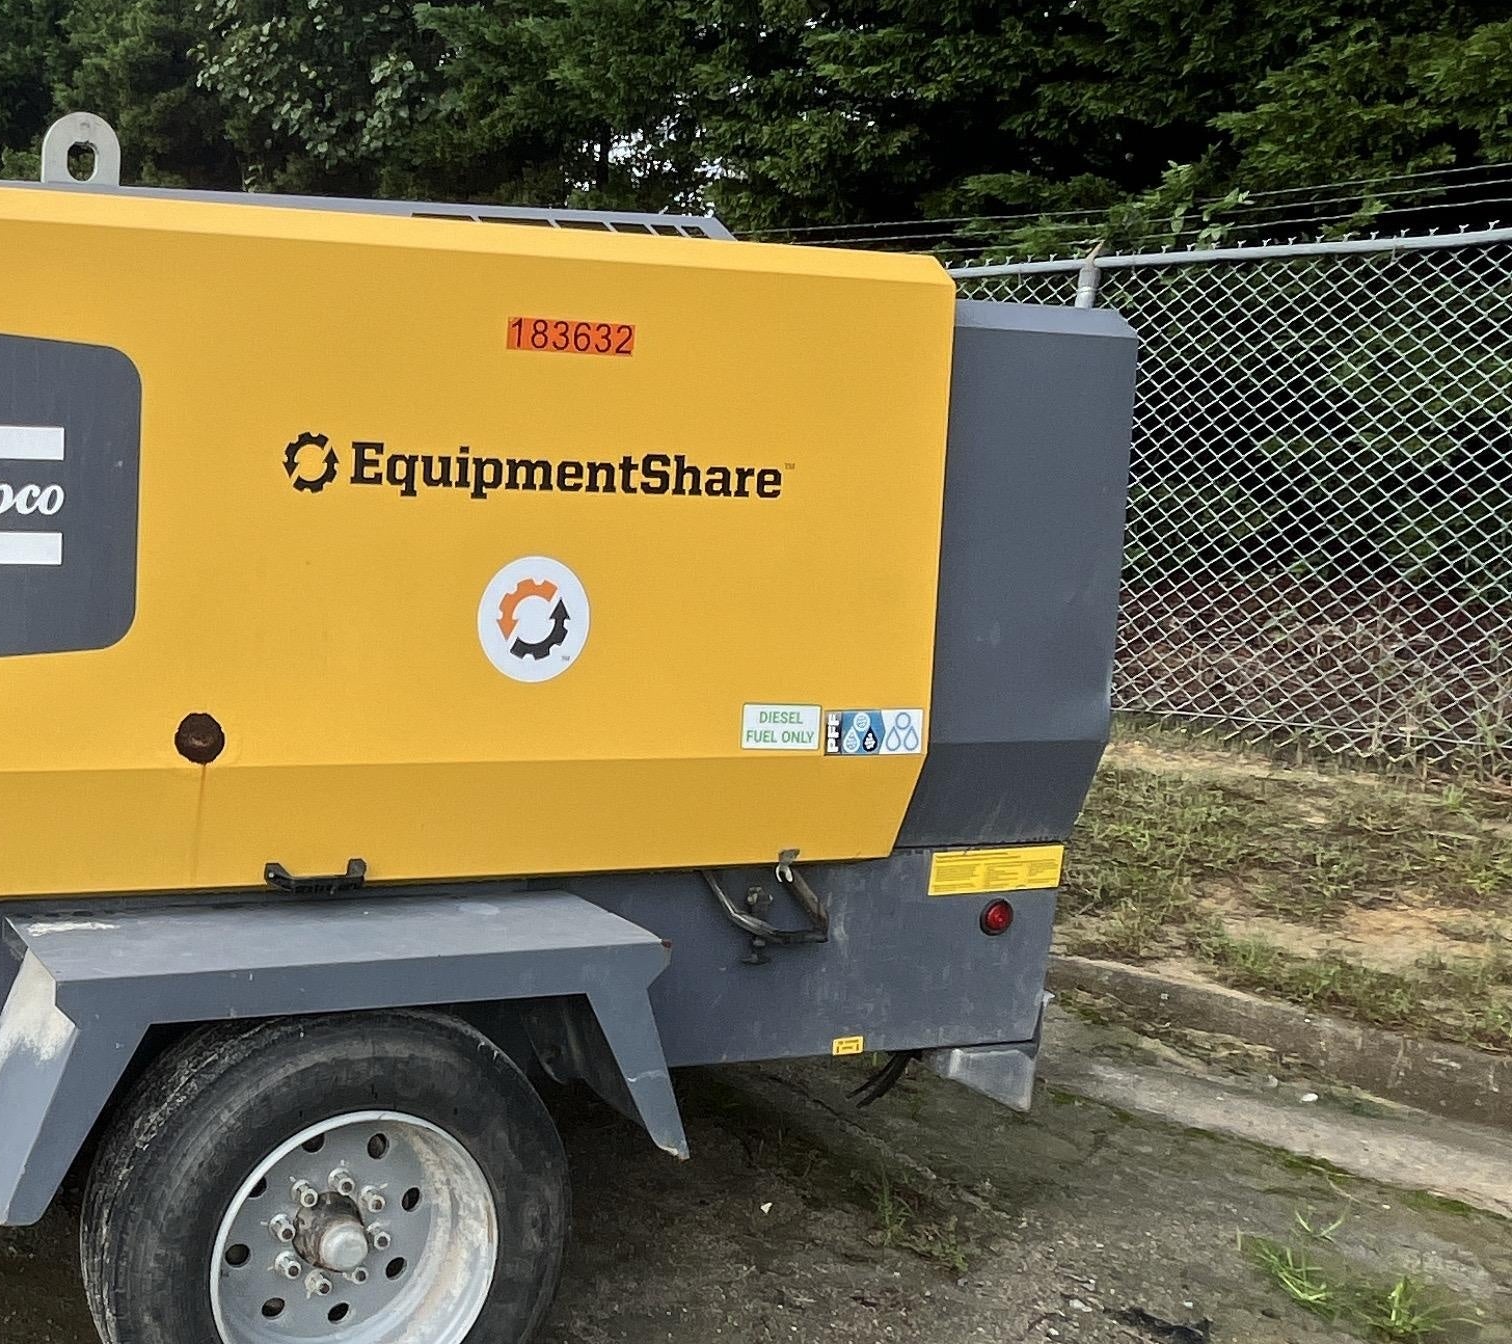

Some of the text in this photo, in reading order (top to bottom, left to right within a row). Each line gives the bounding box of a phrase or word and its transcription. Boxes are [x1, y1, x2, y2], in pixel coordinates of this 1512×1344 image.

[512, 317, 633, 355] 183632
[350, 441, 783, 500] EquipmentShare
[759, 711, 804, 725] DIESEL
[746, 730, 815, 745] FUEL ONLY
